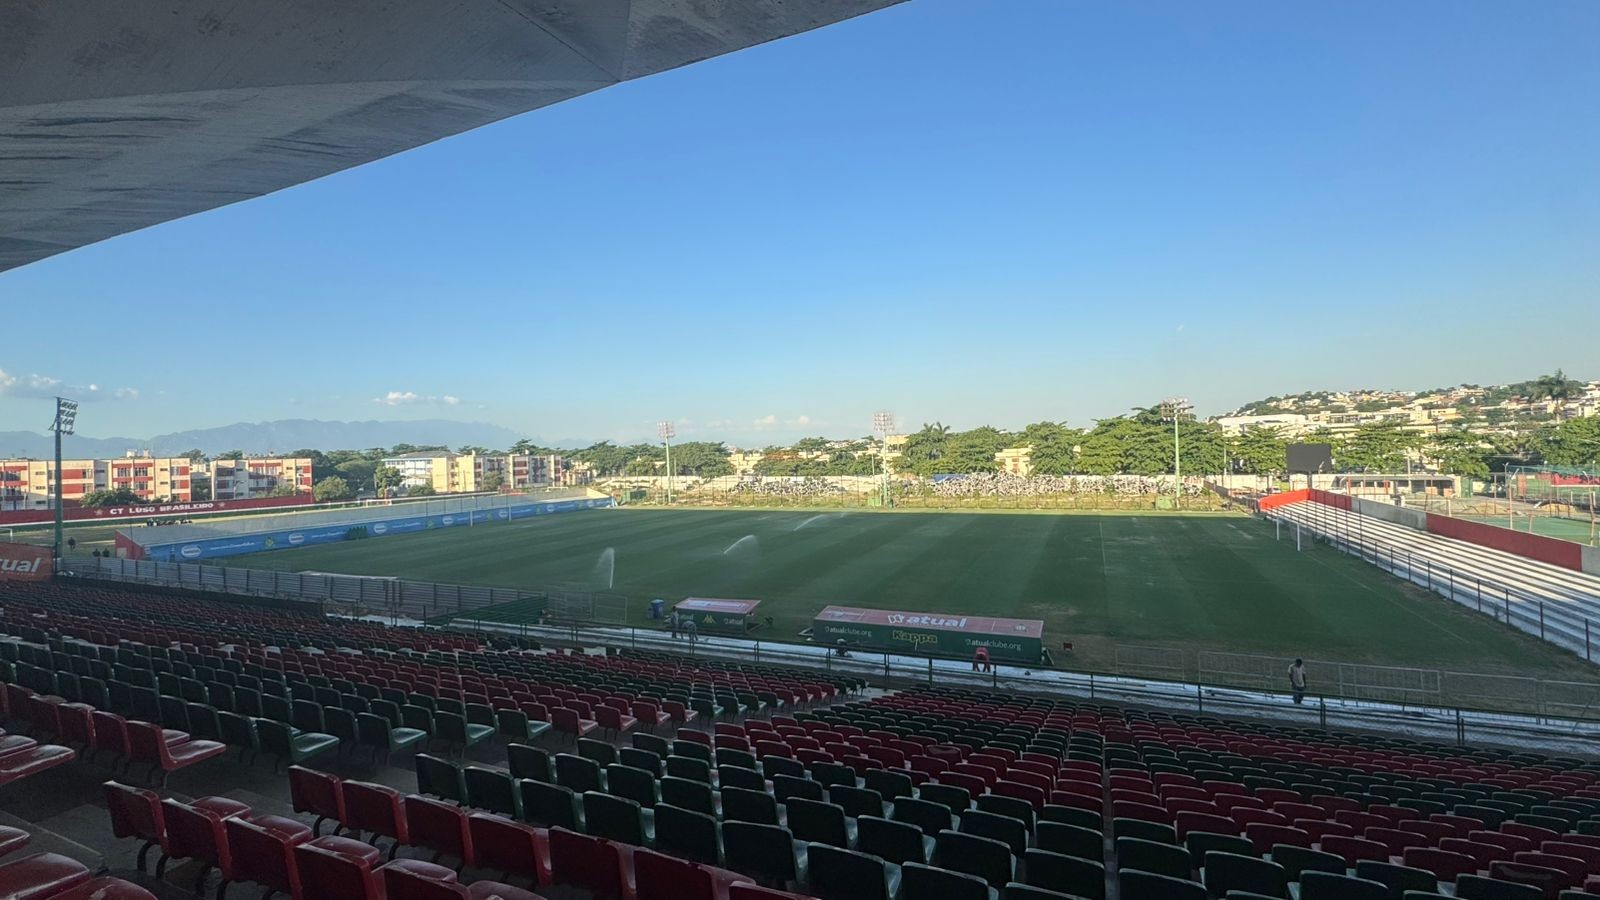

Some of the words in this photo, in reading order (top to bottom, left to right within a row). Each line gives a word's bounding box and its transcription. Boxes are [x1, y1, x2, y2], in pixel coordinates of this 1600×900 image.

[0, 557, 42, 573] ual
[906, 616, 967, 628] atual
[892, 630, 938, 644] Kappa
